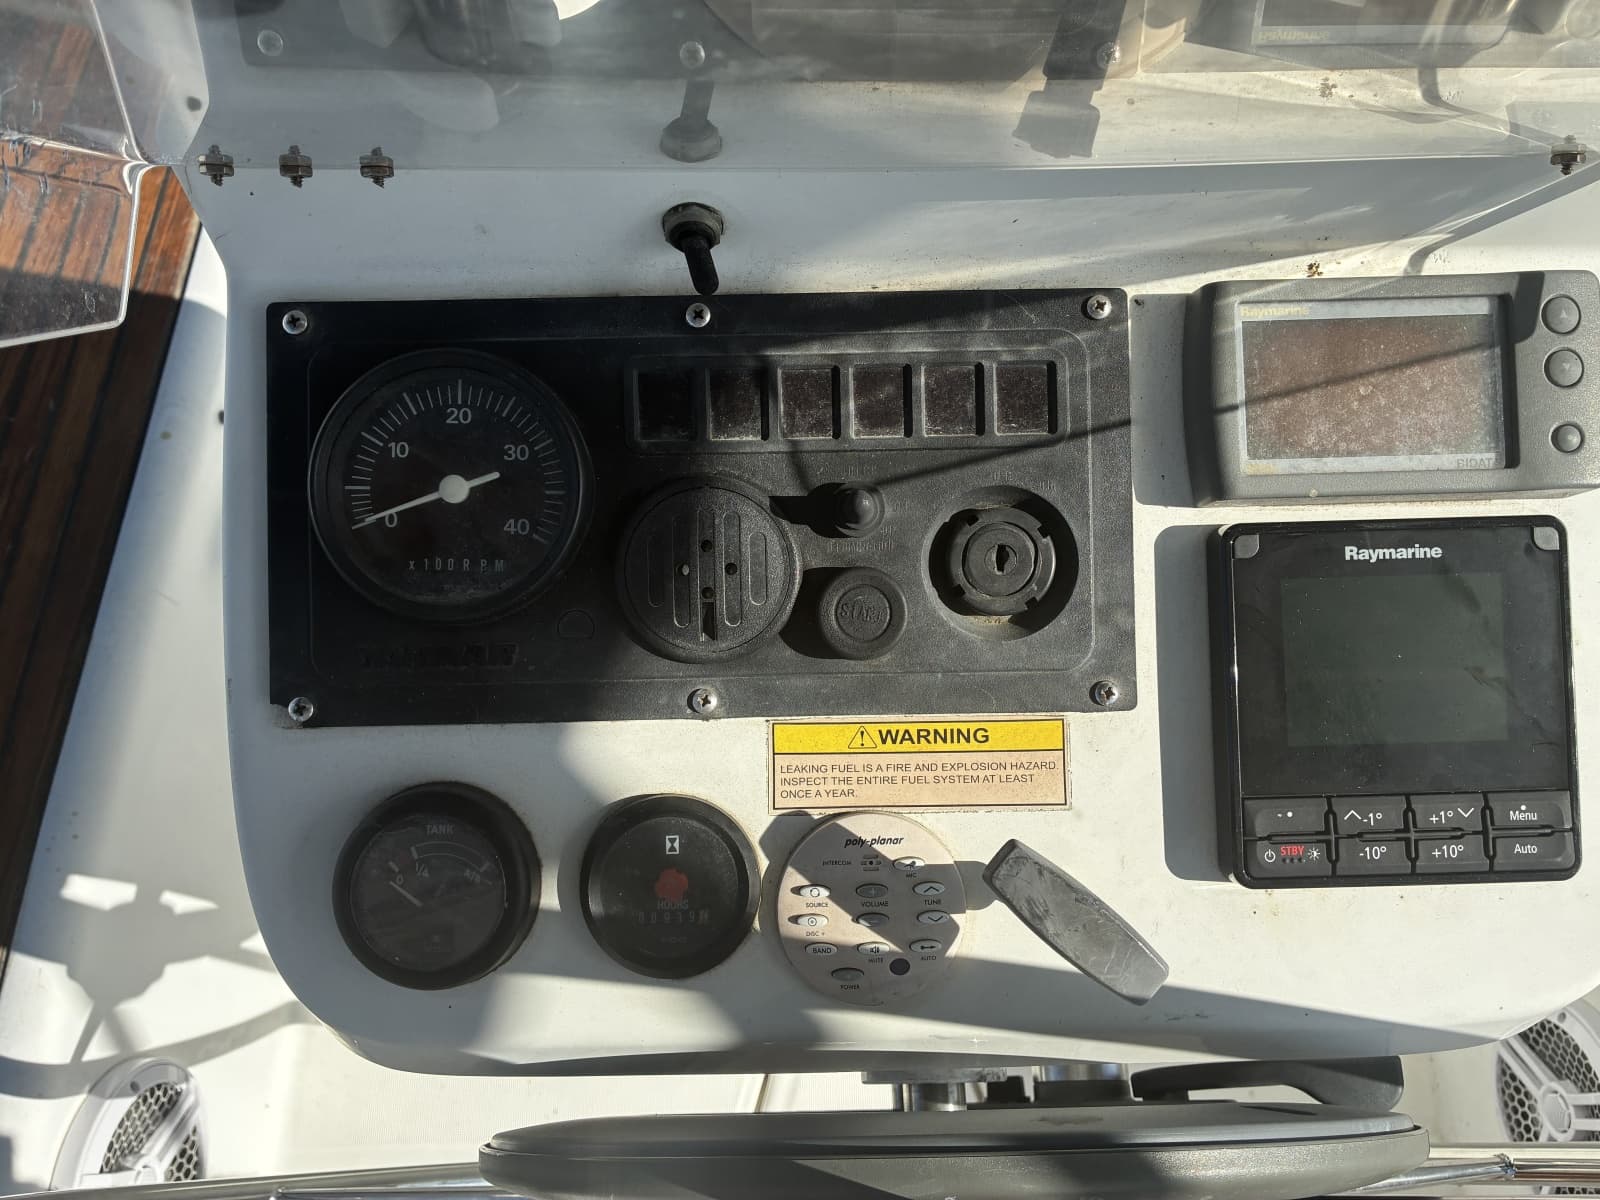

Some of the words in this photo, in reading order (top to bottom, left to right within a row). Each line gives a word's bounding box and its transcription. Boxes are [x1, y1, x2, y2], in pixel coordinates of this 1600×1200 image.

[446, 408, 472, 424] 20
[388, 441, 409, 458] 10
[503, 444, 529, 461] 30
[385, 512, 398, 528] 0
[503, 519, 530, 535] 40
[1344, 543, 1443, 562] Raymarine
[878, 727, 990, 745] WARNING
[780, 764, 828, 774] LEAKING
[831, 763, 860, 774] FUEL
[862, 763, 873, 773] IS
[875, 763, 884, 773] A
[886, 763, 912, 773] FIRE
[914, 762, 938, 772] AND
[941, 761, 1007, 772] EXPLOSION
[1010, 760, 1060, 771] HAZARD.
[780, 776, 828, 787] INSPECT
[831, 776, 853, 786] THE
[856, 775, 898, 785] ENTIRE
[901, 775, 930, 785] FUEL
[933, 774, 980, 785] SYSTEM
[982, 774, 996, 784] AT
[999, 773, 1035, 784] LEAST
[780, 789, 812, 800] ONCE
[814, 789, 822, 799] A
[824, 788, 858, 799] YEAR.
[1509, 808, 1538, 821] Menu
[425, 824, 456, 835] TANK
[844, 835, 904, 848] poly-planar
[1514, 843, 1538, 854] Auto
[1280, 845, 1305, 856] STBY
[812, 947, 832, 955] BAND
